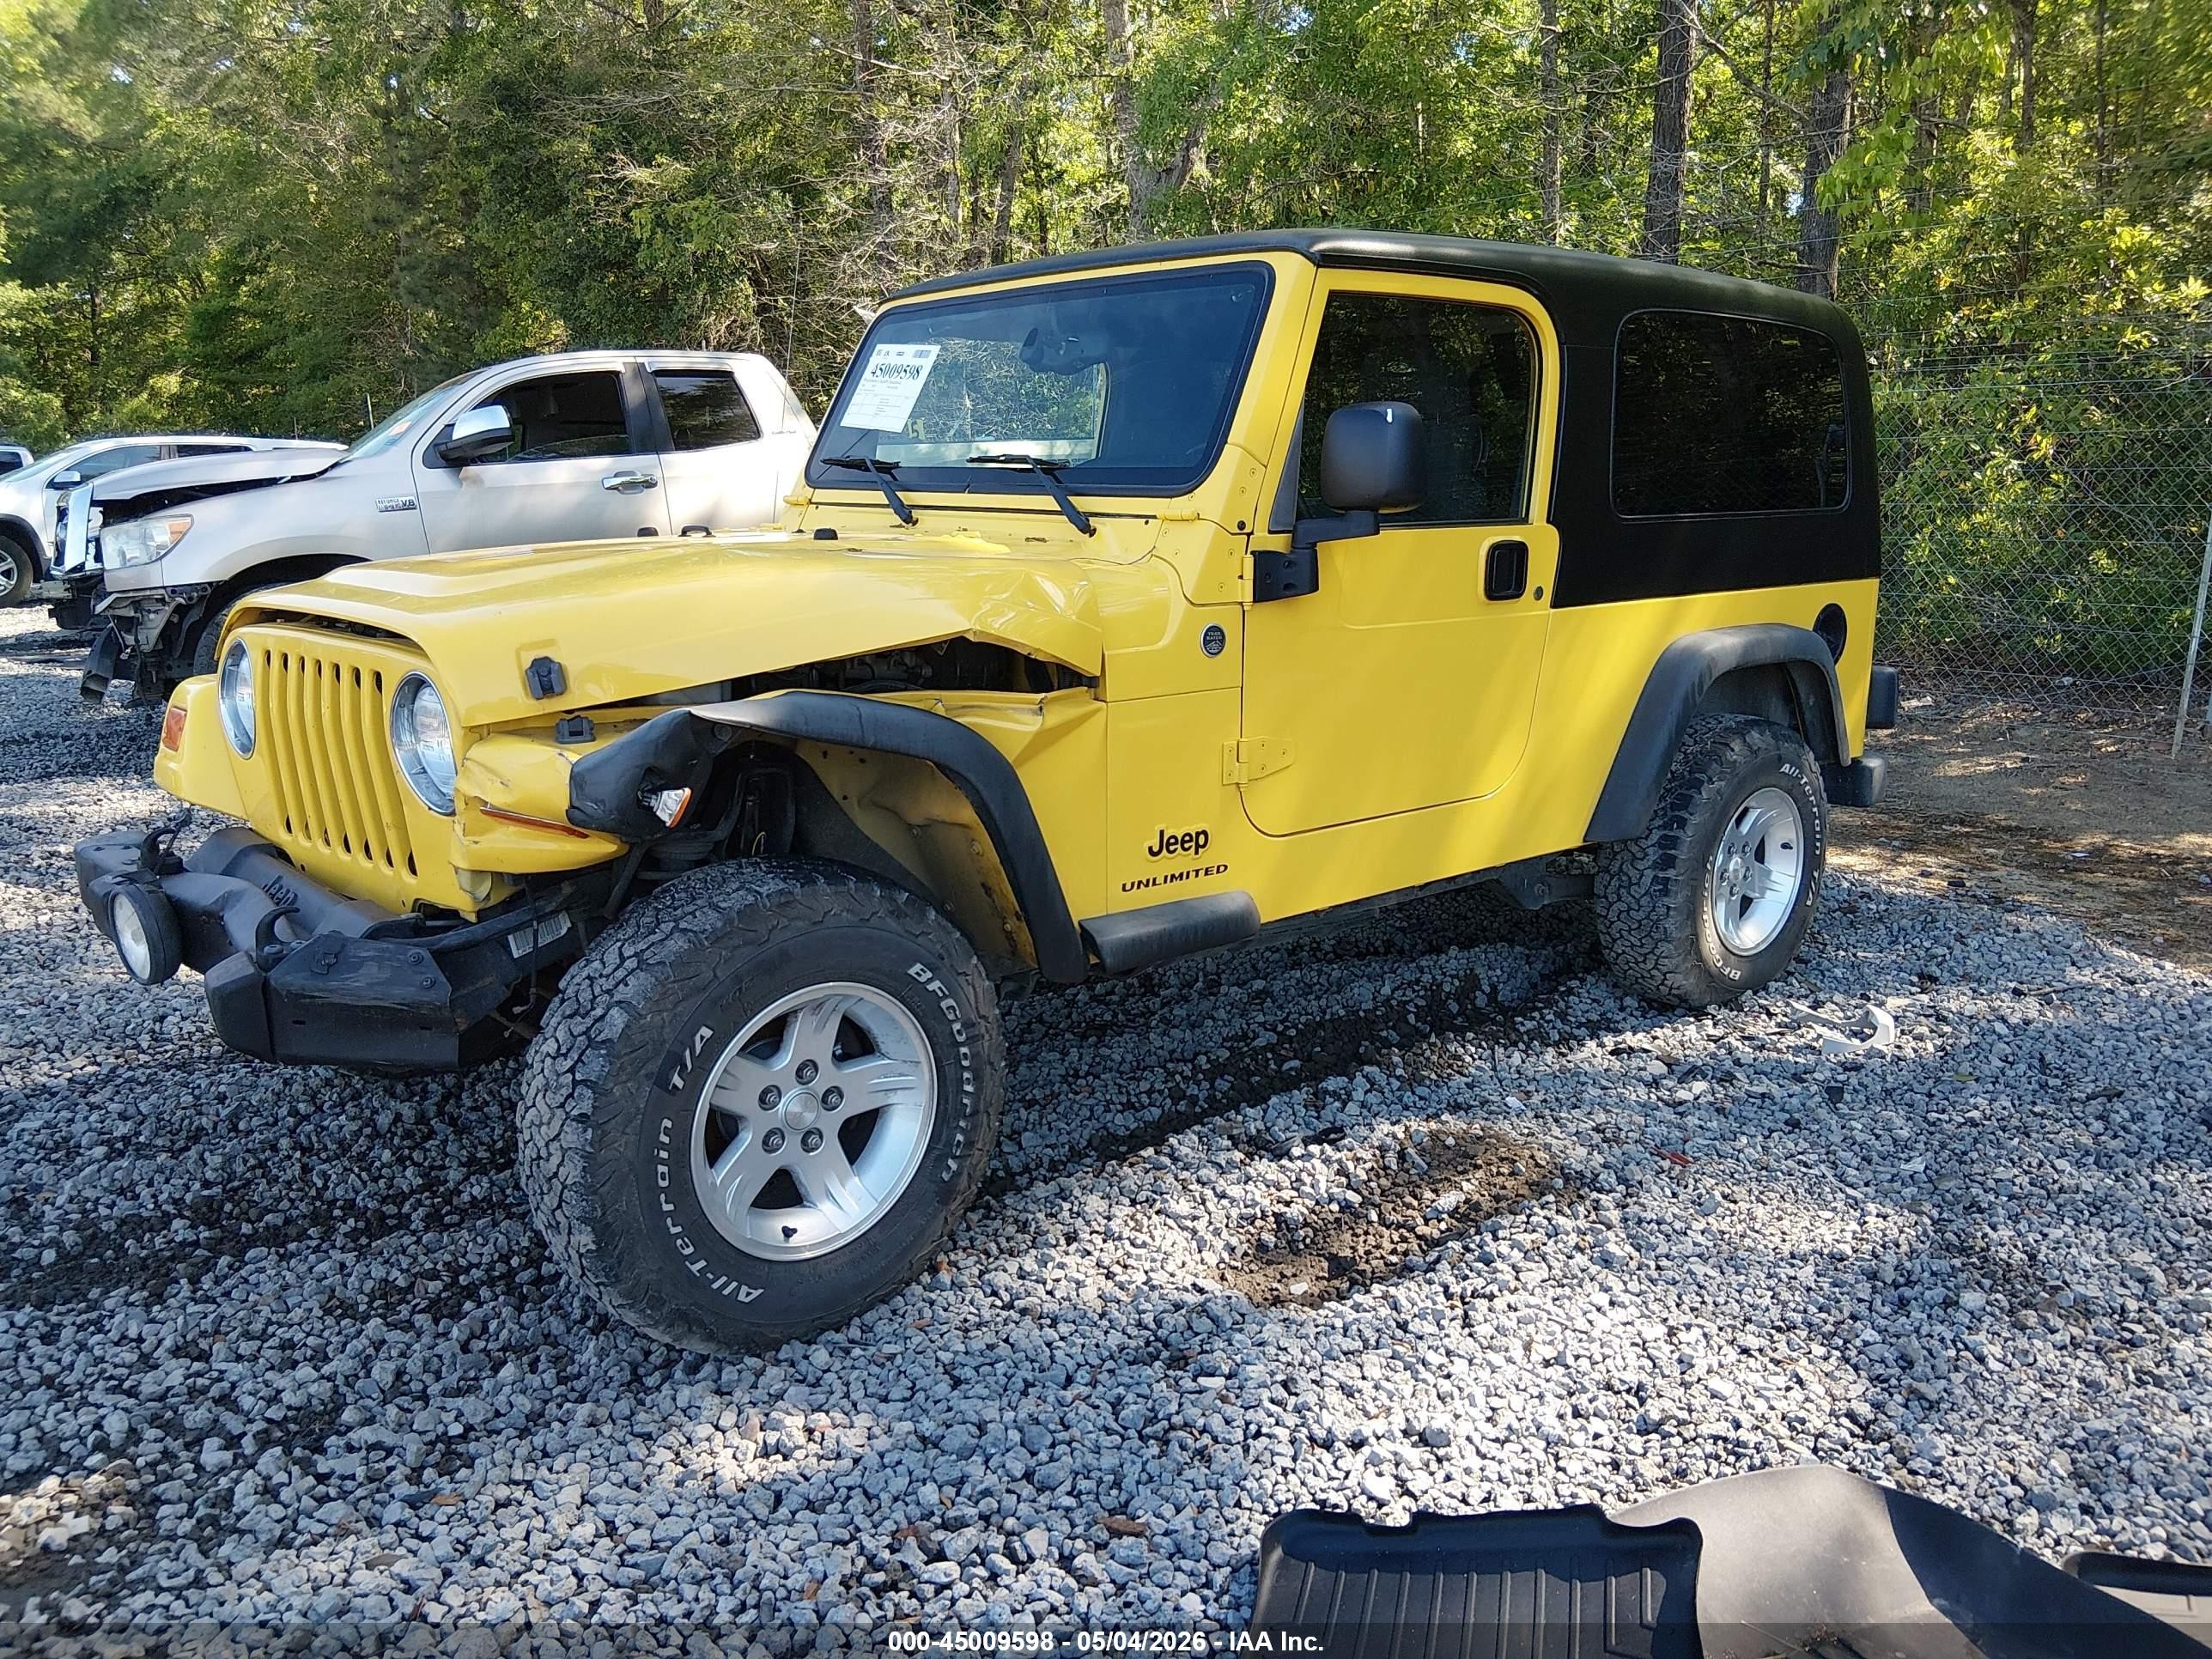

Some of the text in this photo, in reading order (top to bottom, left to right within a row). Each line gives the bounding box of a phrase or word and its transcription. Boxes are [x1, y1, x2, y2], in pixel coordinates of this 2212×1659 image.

[871, 362, 923, 380] 45009598
[1147, 829, 1209, 857] Jeep
[1121, 863, 1229, 893] UNLIMITED
[1805, 868, 1819, 907] T/A
[907, 962, 975, 1182] BFGoodrich
[653, 1024, 764, 1304] All-Terrain T/A
